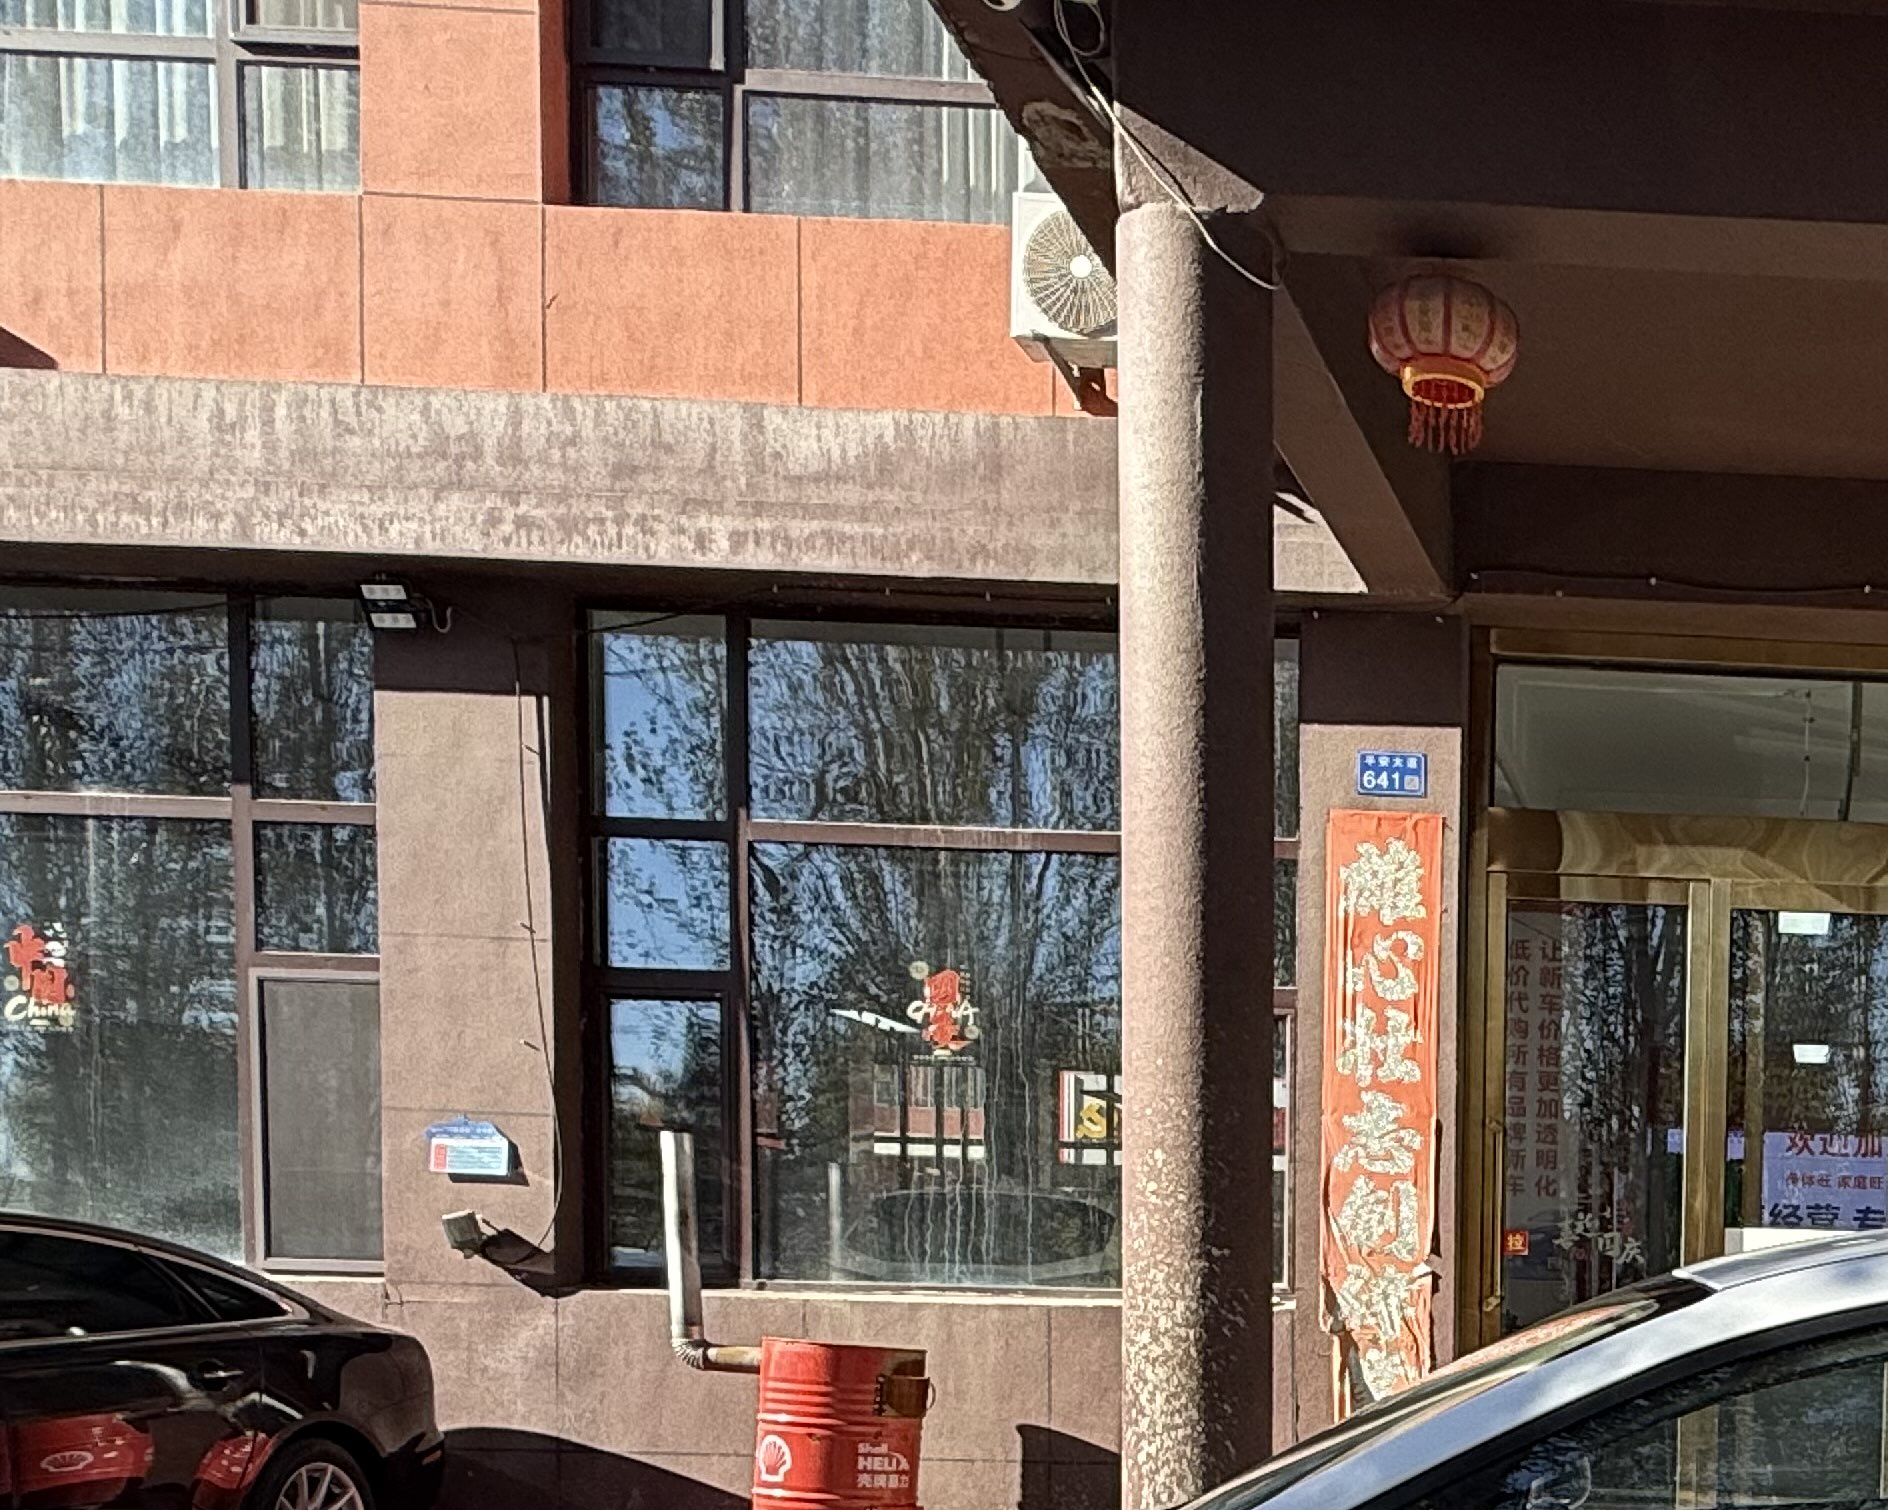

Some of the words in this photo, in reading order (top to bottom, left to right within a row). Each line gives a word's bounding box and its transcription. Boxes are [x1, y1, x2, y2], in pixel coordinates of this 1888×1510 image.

[1363, 770, 1401, 790] 641
[1535, 939, 1563, 1198] 让新车价格更加透明化
[857, 1452, 911, 1472] HELIX
